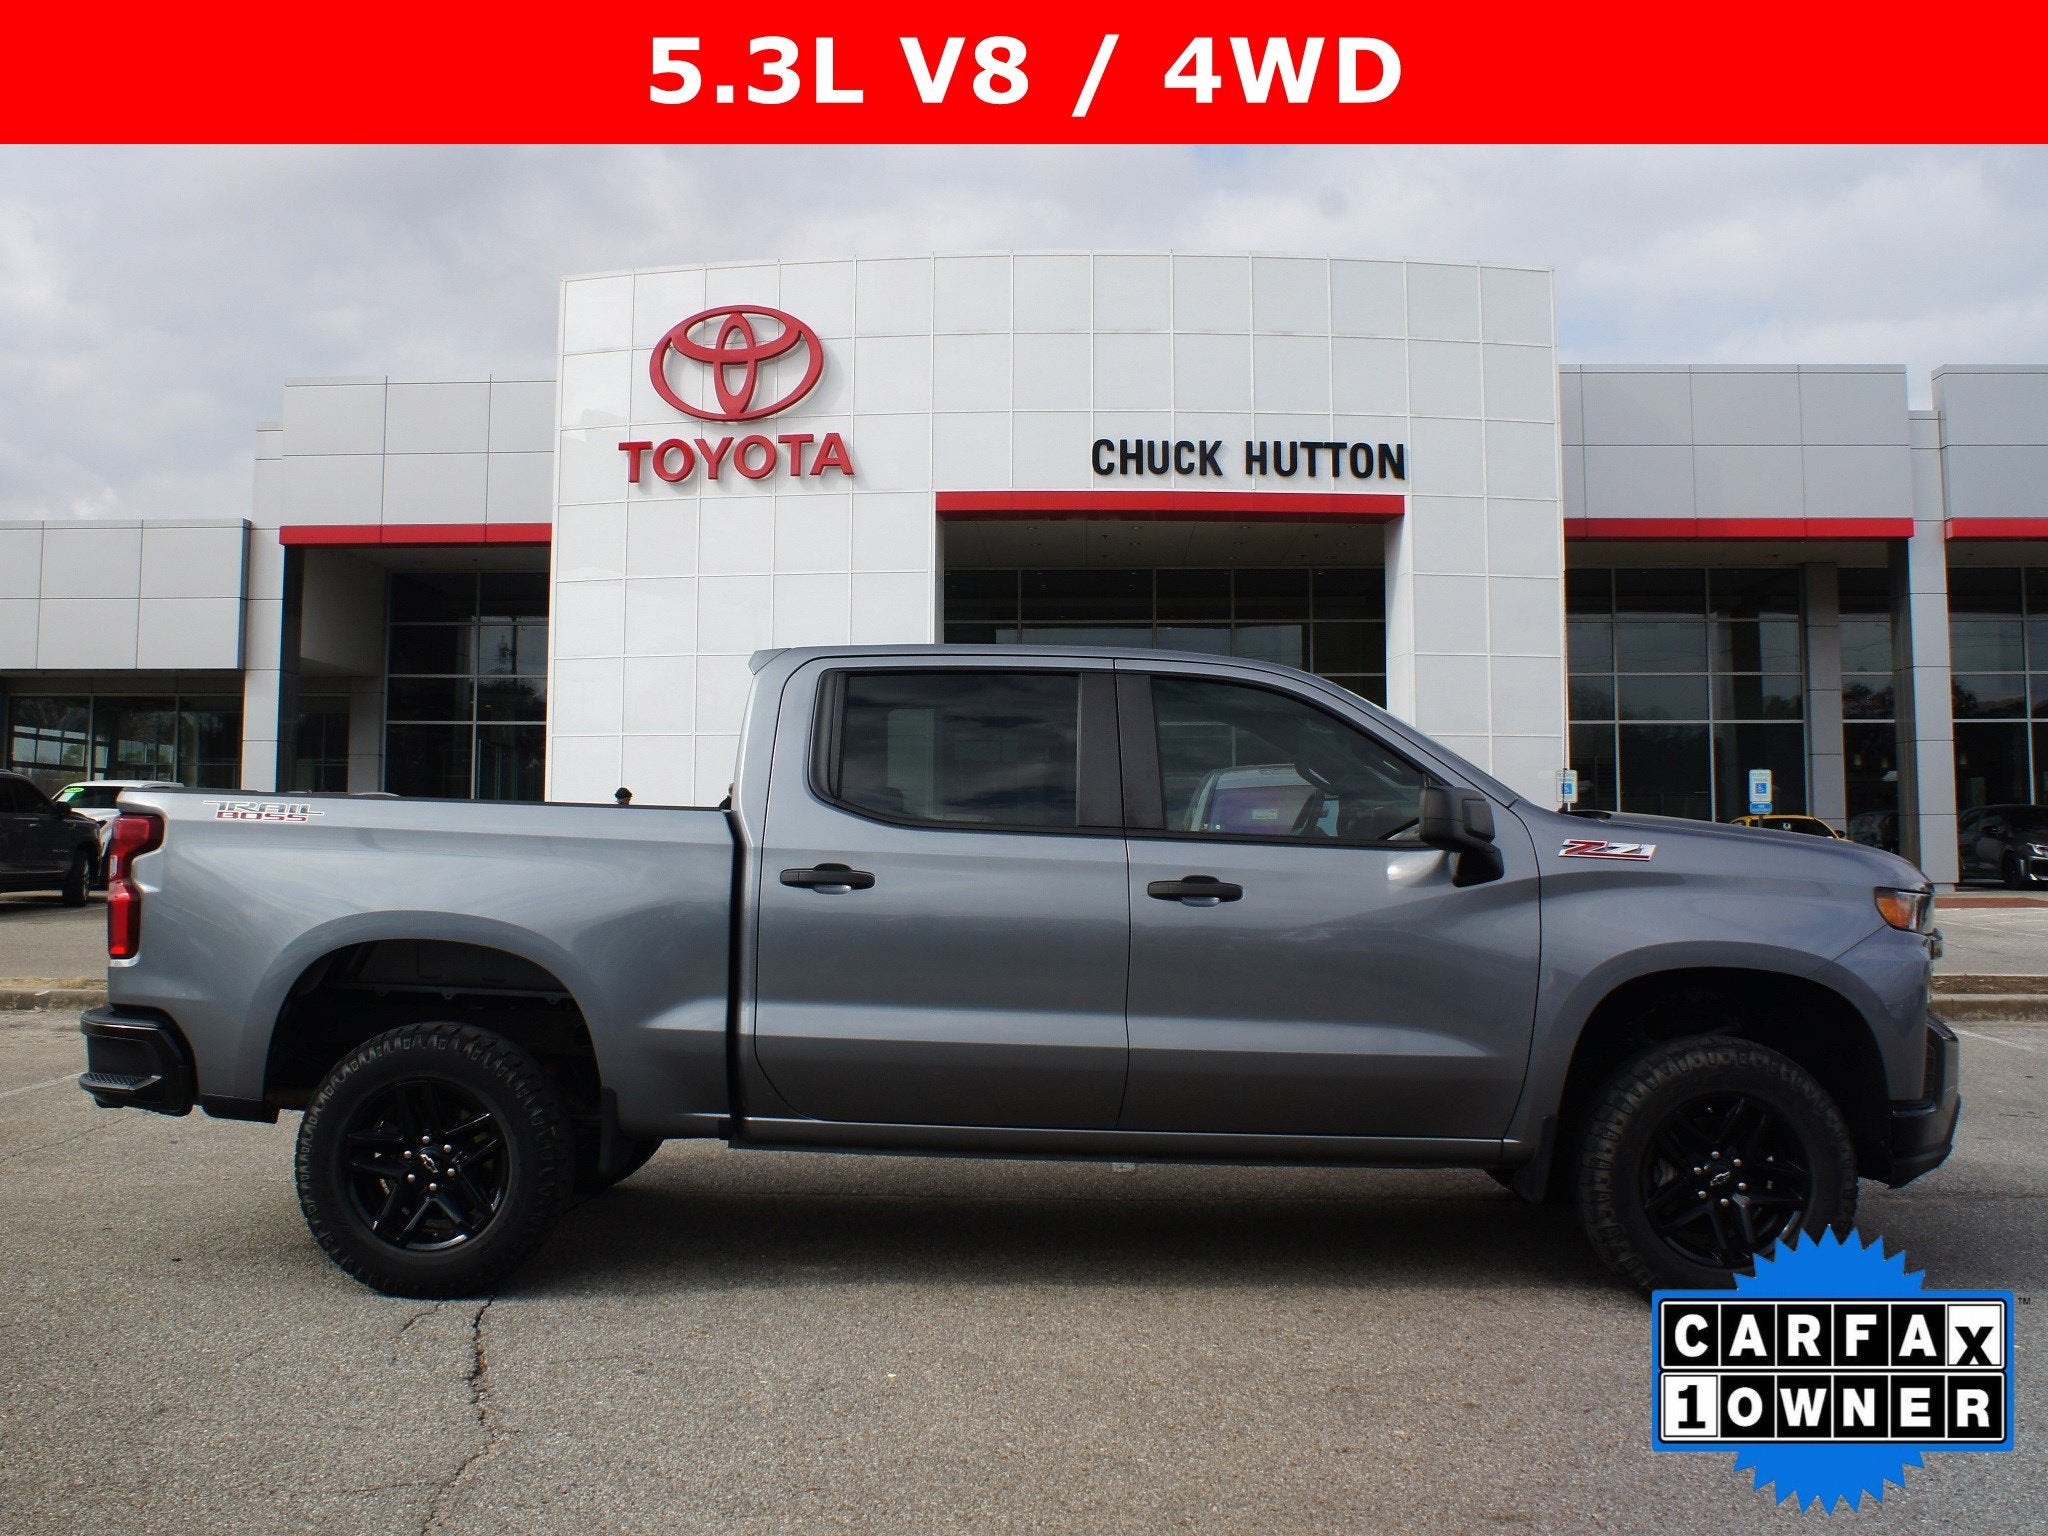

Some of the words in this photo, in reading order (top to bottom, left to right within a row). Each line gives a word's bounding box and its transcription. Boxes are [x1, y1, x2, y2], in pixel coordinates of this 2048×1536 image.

[618, 433, 854, 483] TOYOTA
[1092, 438, 1224, 477] CHUCK
[1245, 440, 1406, 481] HUTTON
[203, 800, 325, 816] TRAIL
[215, 811, 308, 823] BOSS
[1558, 838, 1657, 861] Z71
